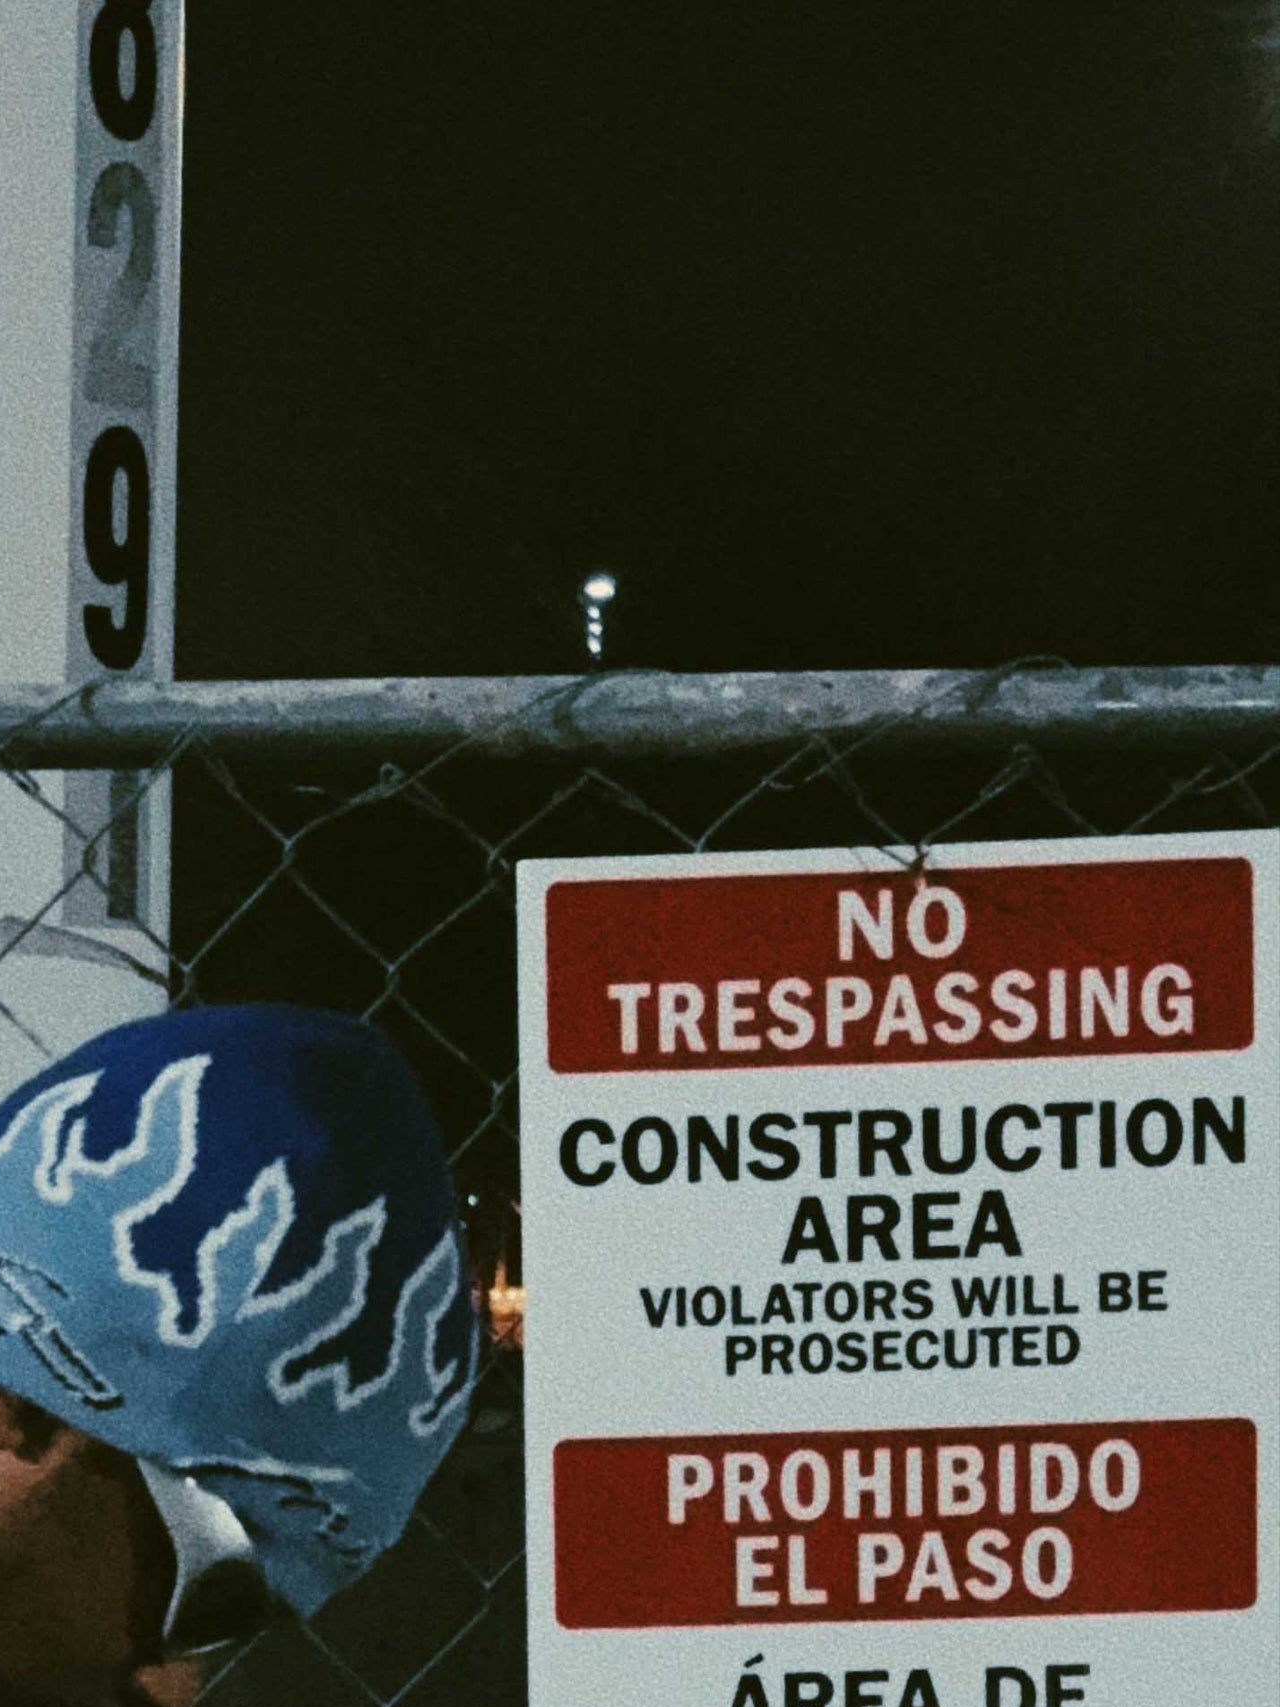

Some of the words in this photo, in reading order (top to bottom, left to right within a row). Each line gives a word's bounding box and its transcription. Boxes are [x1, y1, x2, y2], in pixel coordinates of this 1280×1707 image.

[837, 885, 967, 961] NO
[608, 963, 1194, 1054] TRESPASSING
[558, 1096, 1247, 1186] CONSTRUCTION
[781, 1190, 1023, 1264] AREA
[640, 1279, 934, 1328] VIOLATORS
[953, 1273, 1079, 1317] WILL
[1098, 1270, 1169, 1312] BE
[724, 1326, 1082, 1375] PROSECUTED
[667, 1439, 1140, 1524] PROHIBIDO
[736, 1535, 828, 1607] EL
[857, 1527, 1073, 1603] PASO
